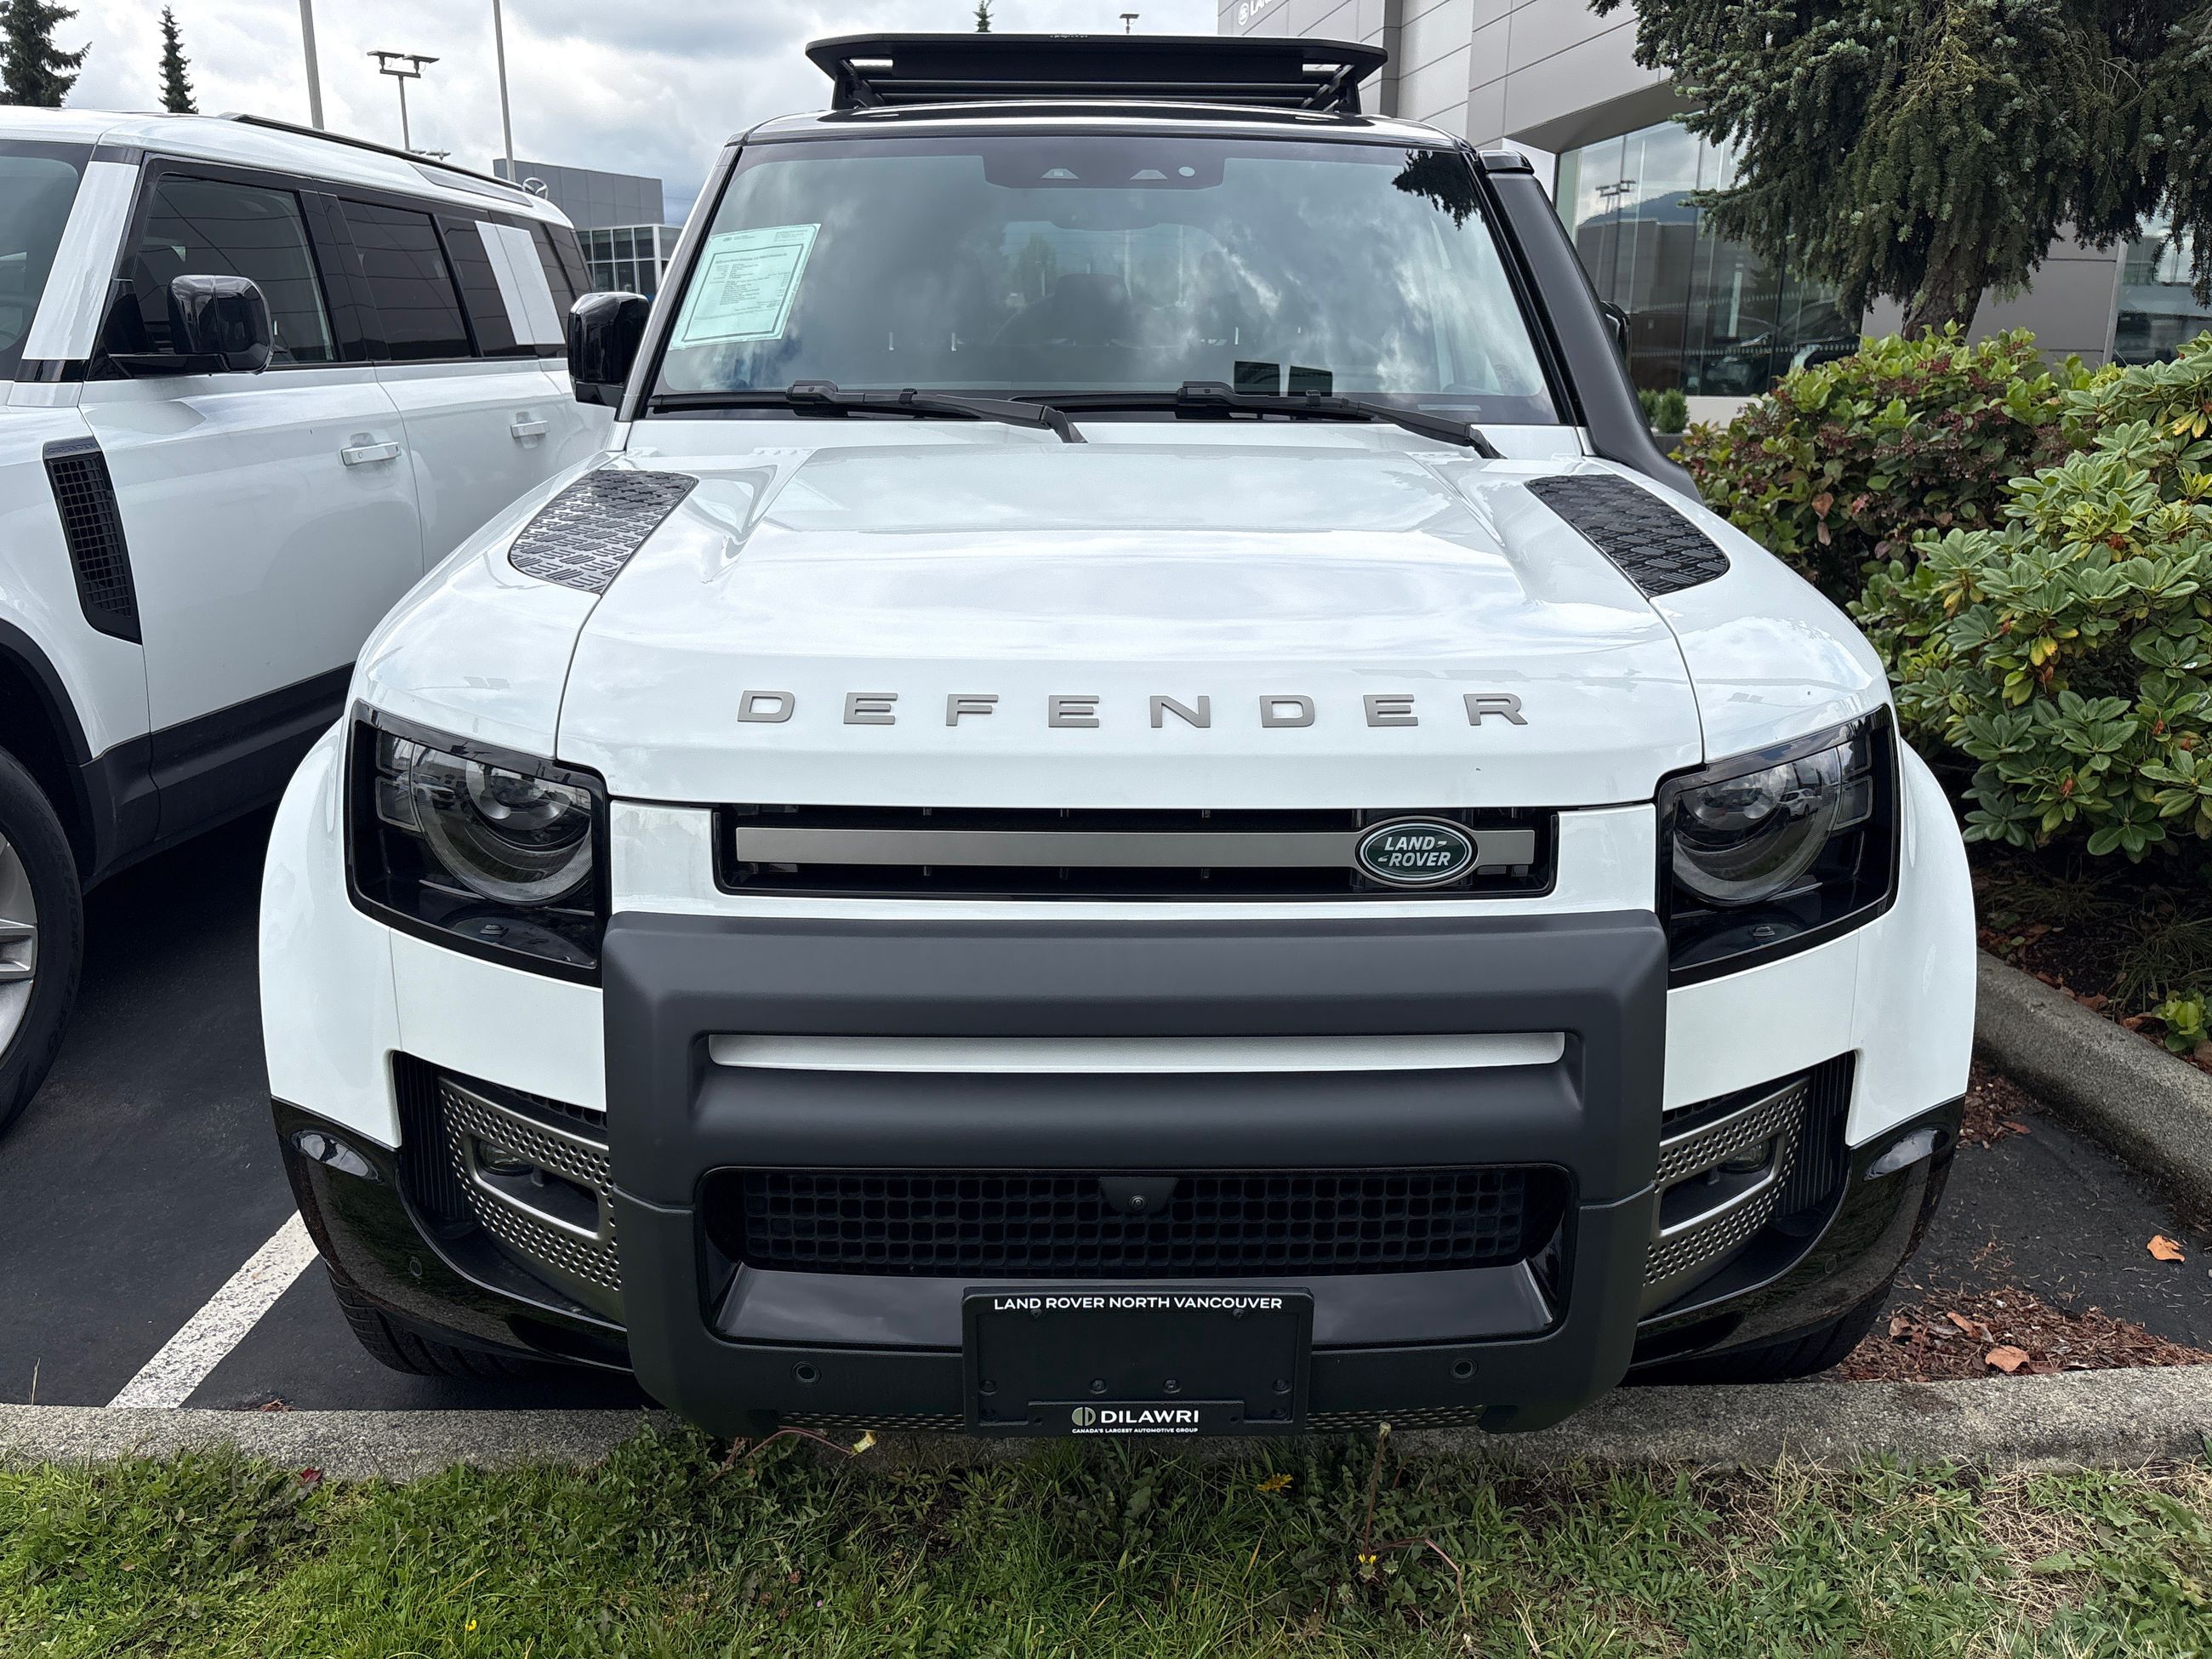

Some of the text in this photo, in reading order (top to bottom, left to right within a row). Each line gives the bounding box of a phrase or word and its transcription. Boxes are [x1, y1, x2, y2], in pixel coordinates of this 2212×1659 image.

[737, 688, 1529, 728] DEFENDER
[1383, 835, 1435, 852] LAND
[1388, 852, 1451, 867] ROVER
[994, 1297, 1283, 1310] LAND ROVER NORTH VANCOUVER
[1100, 1410, 1200, 1423] DILAWRI
